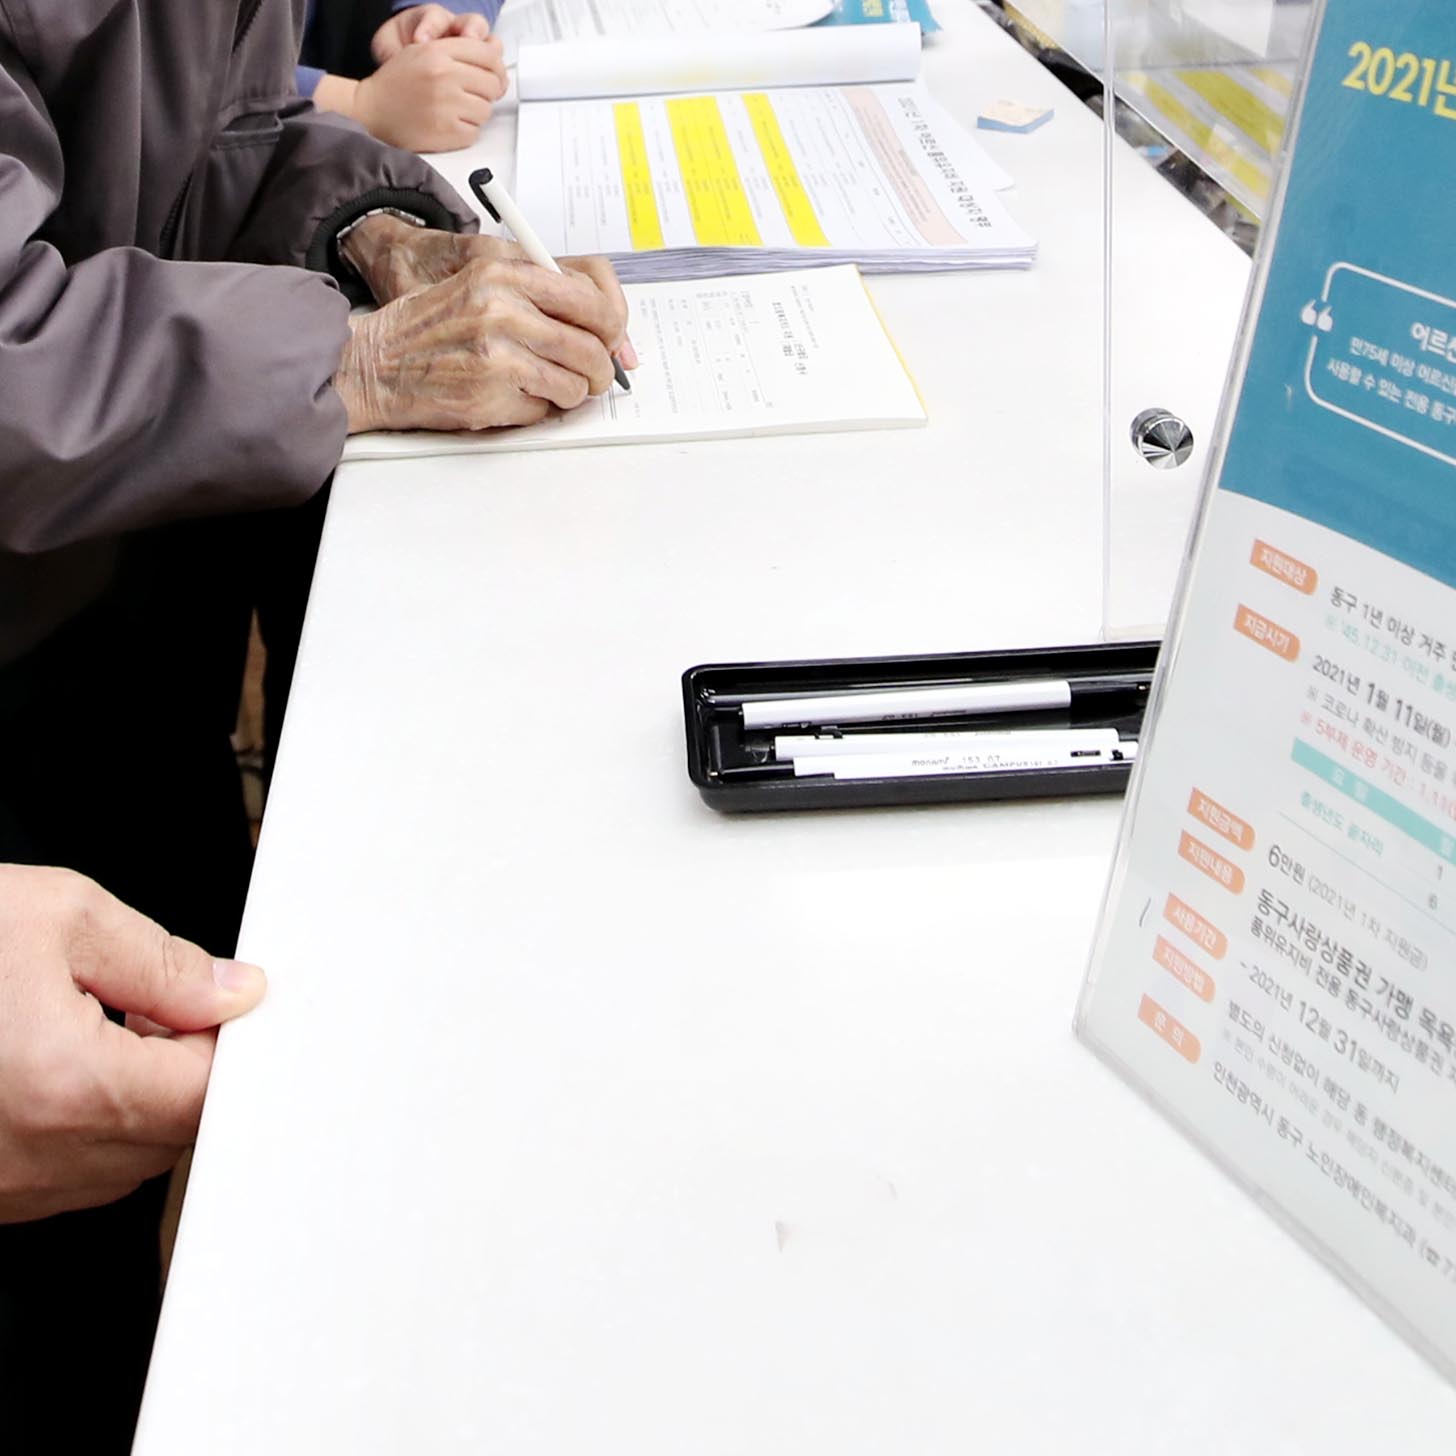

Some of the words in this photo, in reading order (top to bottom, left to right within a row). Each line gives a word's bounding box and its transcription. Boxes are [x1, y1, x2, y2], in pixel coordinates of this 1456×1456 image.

[1350, 337, 1388, 366] 만75세
[1390, 348, 1414, 377] 이상
[1331, 586, 1358, 612] 동구
[1363, 603, 1384, 630] 1년
[1387, 617, 1416, 646] 이상
[1418, 633, 1447, 662] 거주
[1313, 655, 1360, 696] 2021년
[1367, 682, 1390, 712] 1월
[1269, 844, 1306, 885] 6만원
[1251, 915, 1312, 976] 품위유지비
[1258, 889, 1373, 991] 동구사랑상품권
[1375, 977, 1415, 1021] 가맹
[1249, 965, 1293, 1011] 2021년
[1299, 1001, 1332, 1042] 12월
[1214, 1062, 1274, 1126] 인천광역시
[1277, 1116, 1303, 1147] 동구
